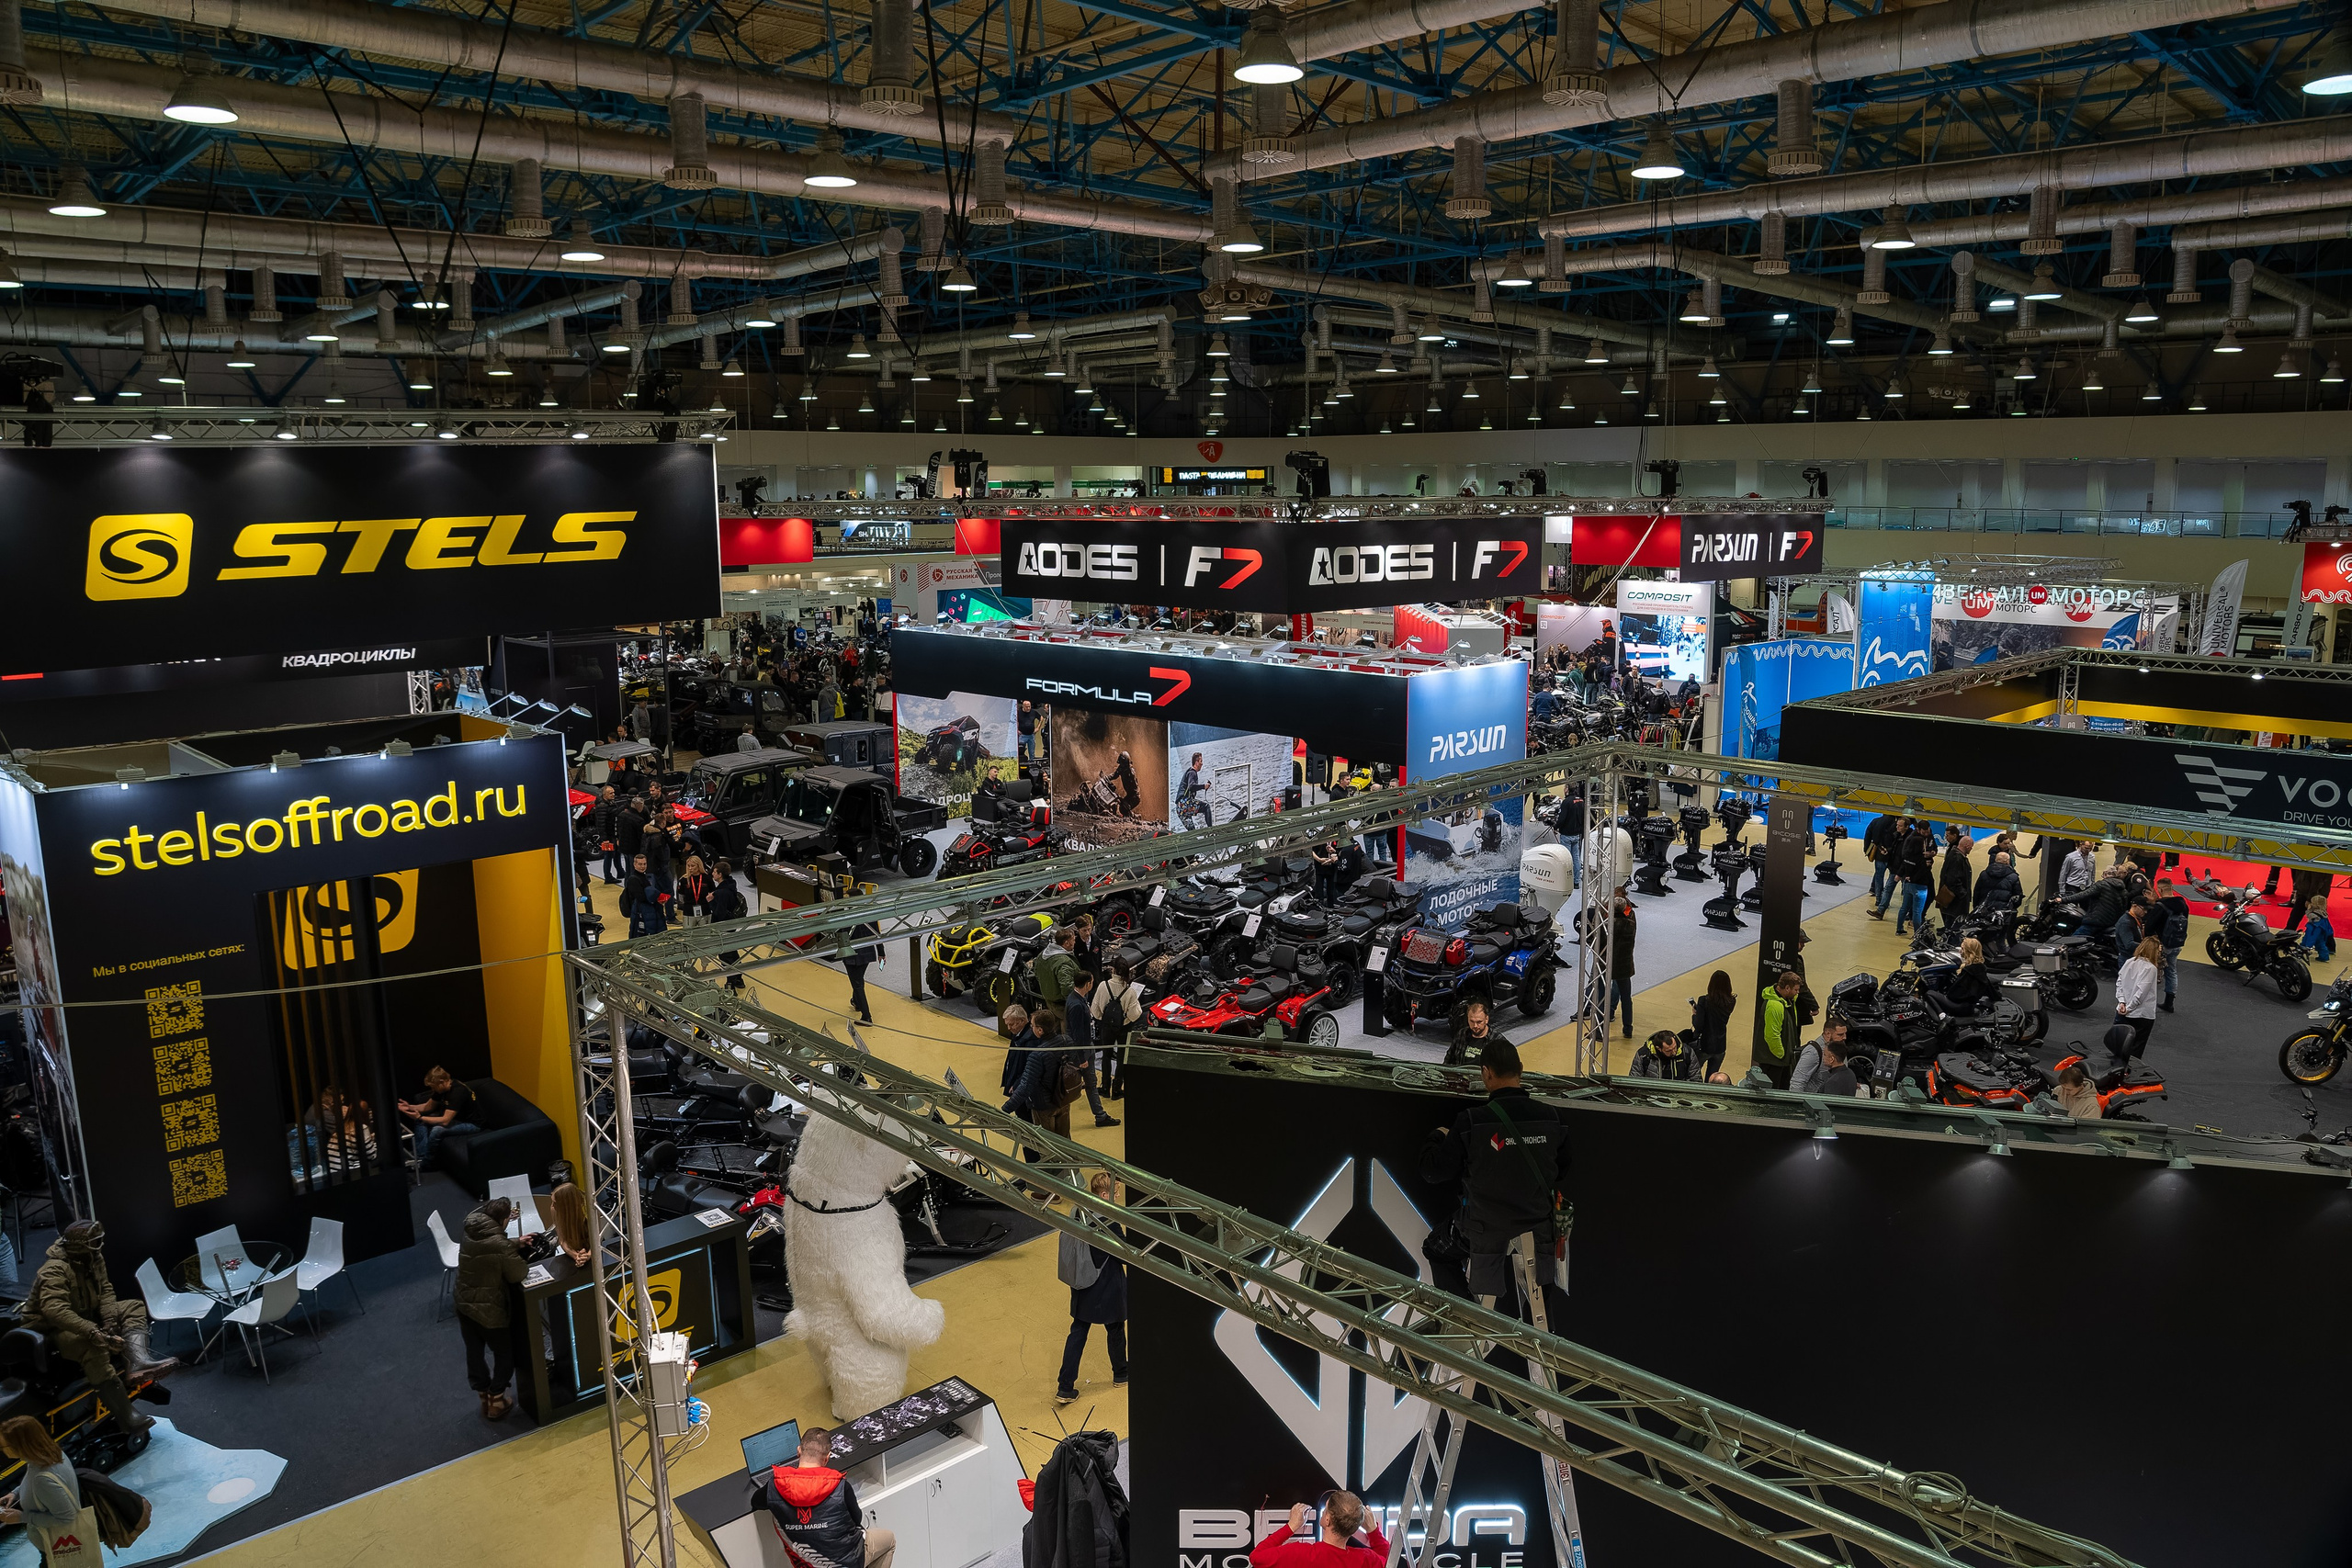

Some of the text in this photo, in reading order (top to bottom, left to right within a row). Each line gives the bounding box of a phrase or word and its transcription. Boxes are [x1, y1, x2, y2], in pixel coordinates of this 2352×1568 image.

[216, 511, 638, 581] STELS
[1691, 530, 1814, 563] PARSUN F7
[1016, 542, 1262, 590] AODES F7
[1308, 540, 1529, 586] AODES F7
[1627, 592, 1692, 602] COMPOSIT
[1996, 604, 2037, 614] МОТОРС
[2220, 605, 2234, 649] MOTORS
[2290, 613, 2302, 646] KARSO
[282, 648, 416, 668] КВАДРОЦИКЛЫ
[1429, 724, 1507, 763] PARSUN
[2278, 774, 2352, 808] VO
[90, 780, 527, 876] stelsoffroad.ru
[2283, 810, 2324, 825] DRIVE
[1771, 829, 1802, 840] BICOSE
[1521, 863, 1551, 878] PARSUN
[1430, 878, 1498, 910] ЛОДОЧНЫЕ
[1704, 908, 1728, 918] PARSUN
[93, 943, 245, 977] Мы в социальных сетях:
[1762, 959, 1792, 971] BICOSE
[804, 1521, 828, 1529] MARINE
[1179, 1505, 1526, 1549] BEDA
